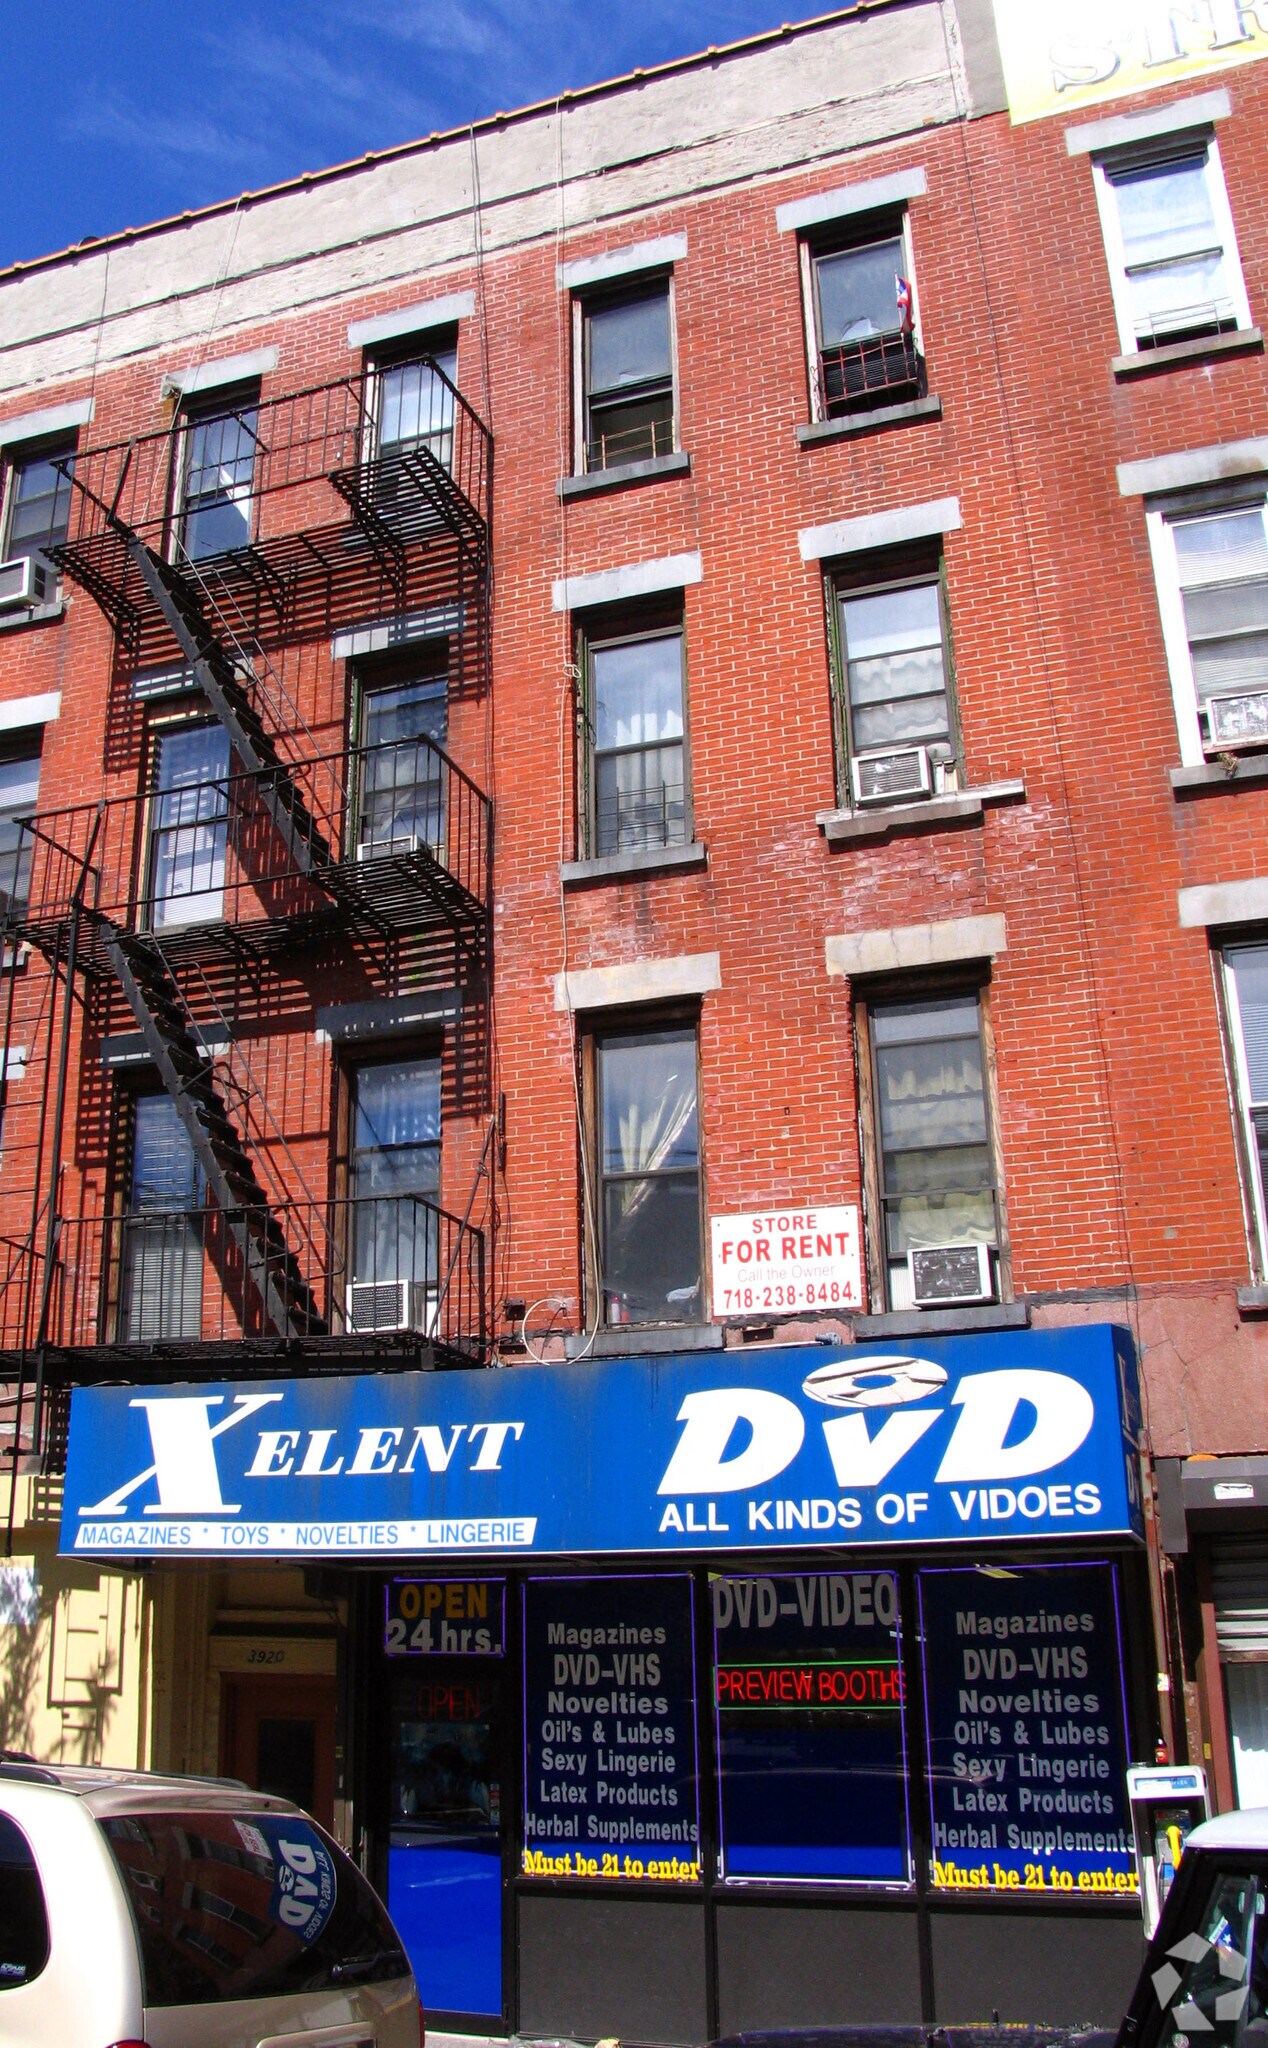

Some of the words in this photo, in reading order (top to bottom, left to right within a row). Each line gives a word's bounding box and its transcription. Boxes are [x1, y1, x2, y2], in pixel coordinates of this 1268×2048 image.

[752, 1214, 818, 1233] STORE
[722, 1238, 771, 1264] FOR
[781, 1233, 850, 1260] RENT
[738, 1268, 763, 1283] Call
[766, 1267, 787, 1282] the
[791, 1264, 836, 1278] Owner
[724, 1281, 852, 1309] 718-238-8484
[658, 1503, 729, 1532] ALL
[749, 1498, 861, 1530] KINDS
[876, 1492, 928, 1524] OF
[950, 1483, 1101, 1520] VIDOES
[82, 1525, 191, 1545] MAGAZINES
[221, 1525, 270, 1545] TOYS
[296, 1524, 399, 1545] NOVELTIES
[427, 1522, 525, 1543] LINGERIE
[400, 1583, 487, 1619] OPEN
[713, 1573, 898, 1628] DVD-VIDEO
[547, 1622, 667, 1649] Magazines
[956, 1609, 1095, 1639] Magazines
[247, 1649, 285, 1664] 3920
[554, 1653, 661, 1686] DVD-VHS
[963, 1645, 1088, 1680] DVD-VHS
[717, 1669, 813, 1701] PREVIEW
[818, 1669, 906, 1701] BOOTHS
[417, 1682, 481, 1720] OPEN
[548, 1691, 668, 1714] Novelties
[958, 1688, 1100, 1713] Novelties
[541, 1719, 583, 1743] Oil's
[592, 1720, 605, 1743] &
[616, 1720, 676, 1744] Lubes
[954, 1719, 1002, 1744] Oil's
[1013, 1719, 1029, 1744] &
[1041, 1720, 1110, 1745] Lubes
[541, 1747, 587, 1776] Sexy
[597, 1749, 676, 1777] Lingerie
[953, 1752, 1006, 1782] Sexy
[1018, 1753, 1110, 1783] Lingerie
[540, 1779, 588, 1804] Latex
[596, 1781, 679, 1806] Products
[952, 1787, 1008, 1812] Latex
[1018, 1787, 1114, 1814] Products
[526, 1812, 579, 1837] Herbal
[587, 1814, 699, 1844] Supplements
[935, 1822, 997, 1848] Herbal
[1007, 1823, 1136, 1855] Supplements
[524, 1850, 571, 1876] Must
[575, 1852, 598, 1877] be
[601, 1853, 620, 1878] 21
[624, 1855, 644, 1879] to
[647, 1857, 699, 1880] enter
[934, 1861, 989, 1888] Must
[993, 1862, 1020, 1889] be
[1024, 1863, 1046, 1890] 21
[1050, 1866, 1074, 1891] to
[1078, 1867, 1139, 1893] enter
